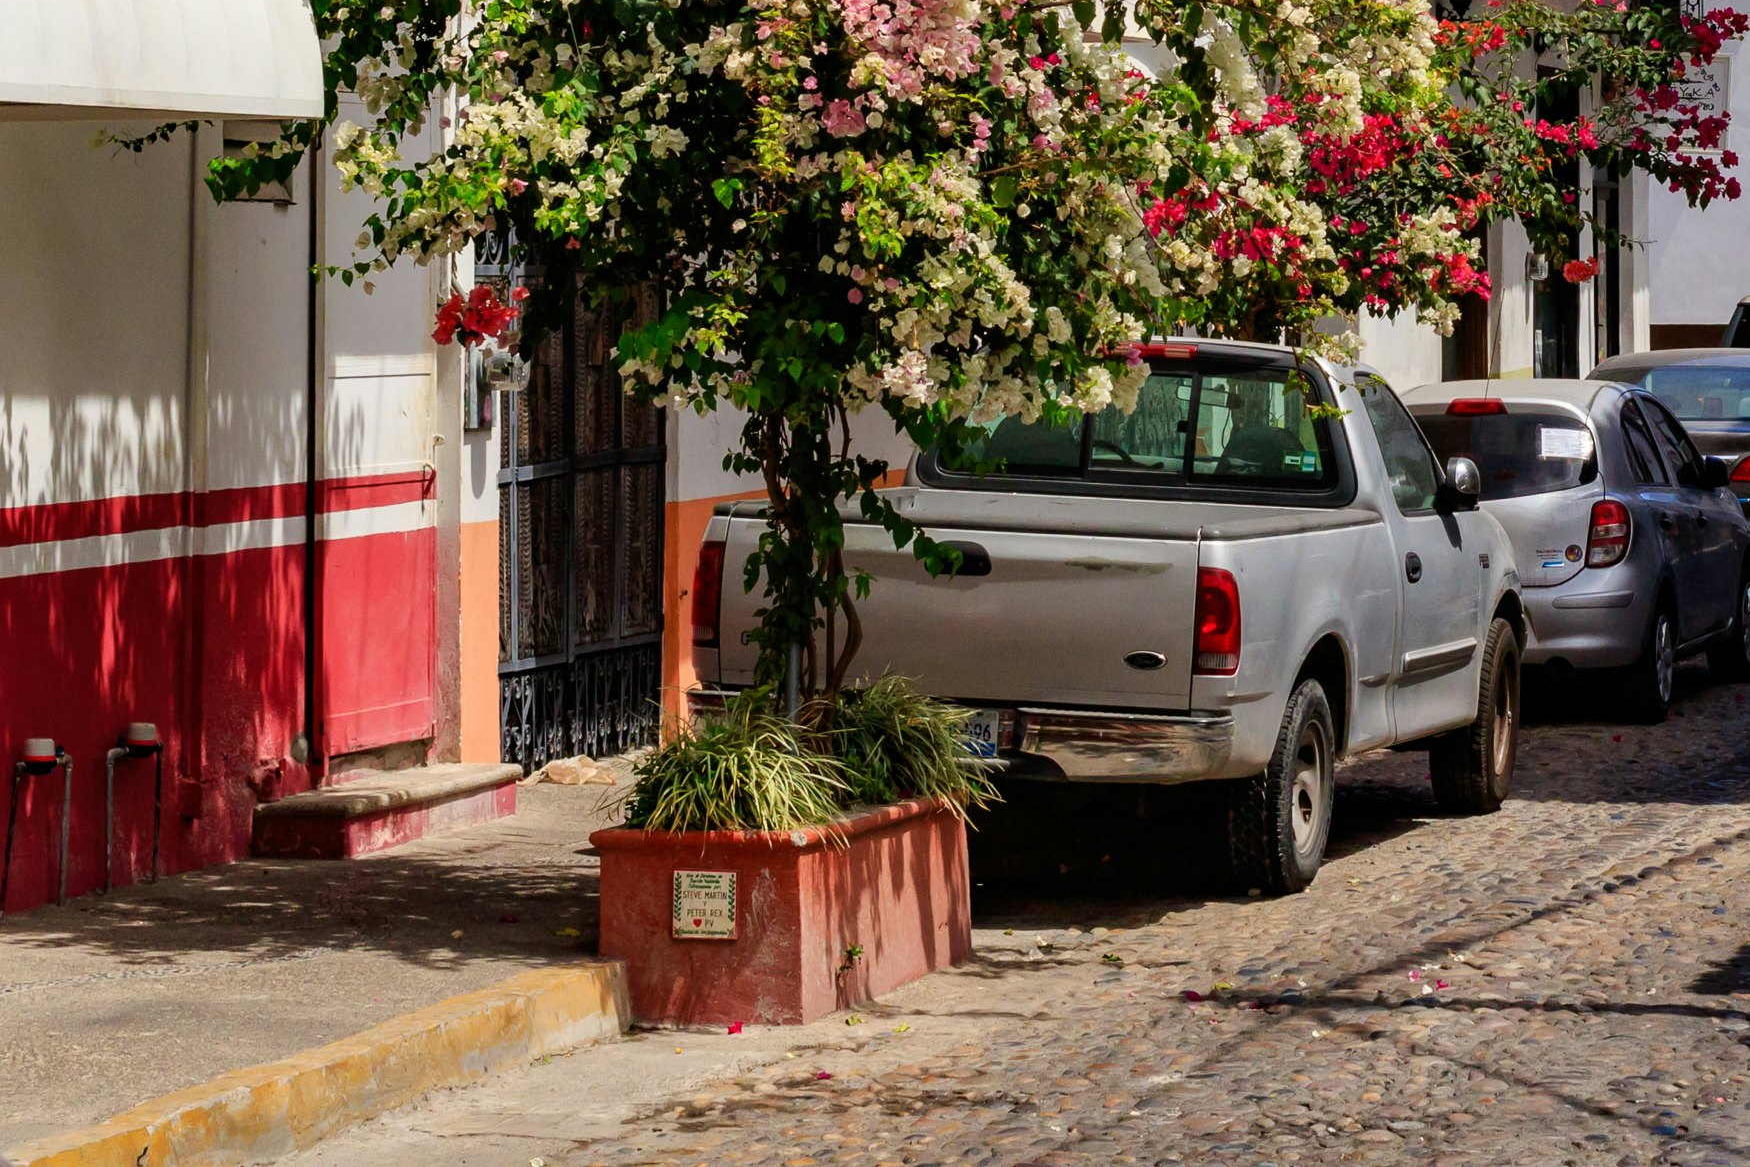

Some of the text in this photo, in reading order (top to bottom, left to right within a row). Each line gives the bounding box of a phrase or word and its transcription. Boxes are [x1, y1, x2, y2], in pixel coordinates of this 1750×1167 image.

[683, 891, 728, 900] STEVE MARTIN
[687, 908, 707, 917] PETER
